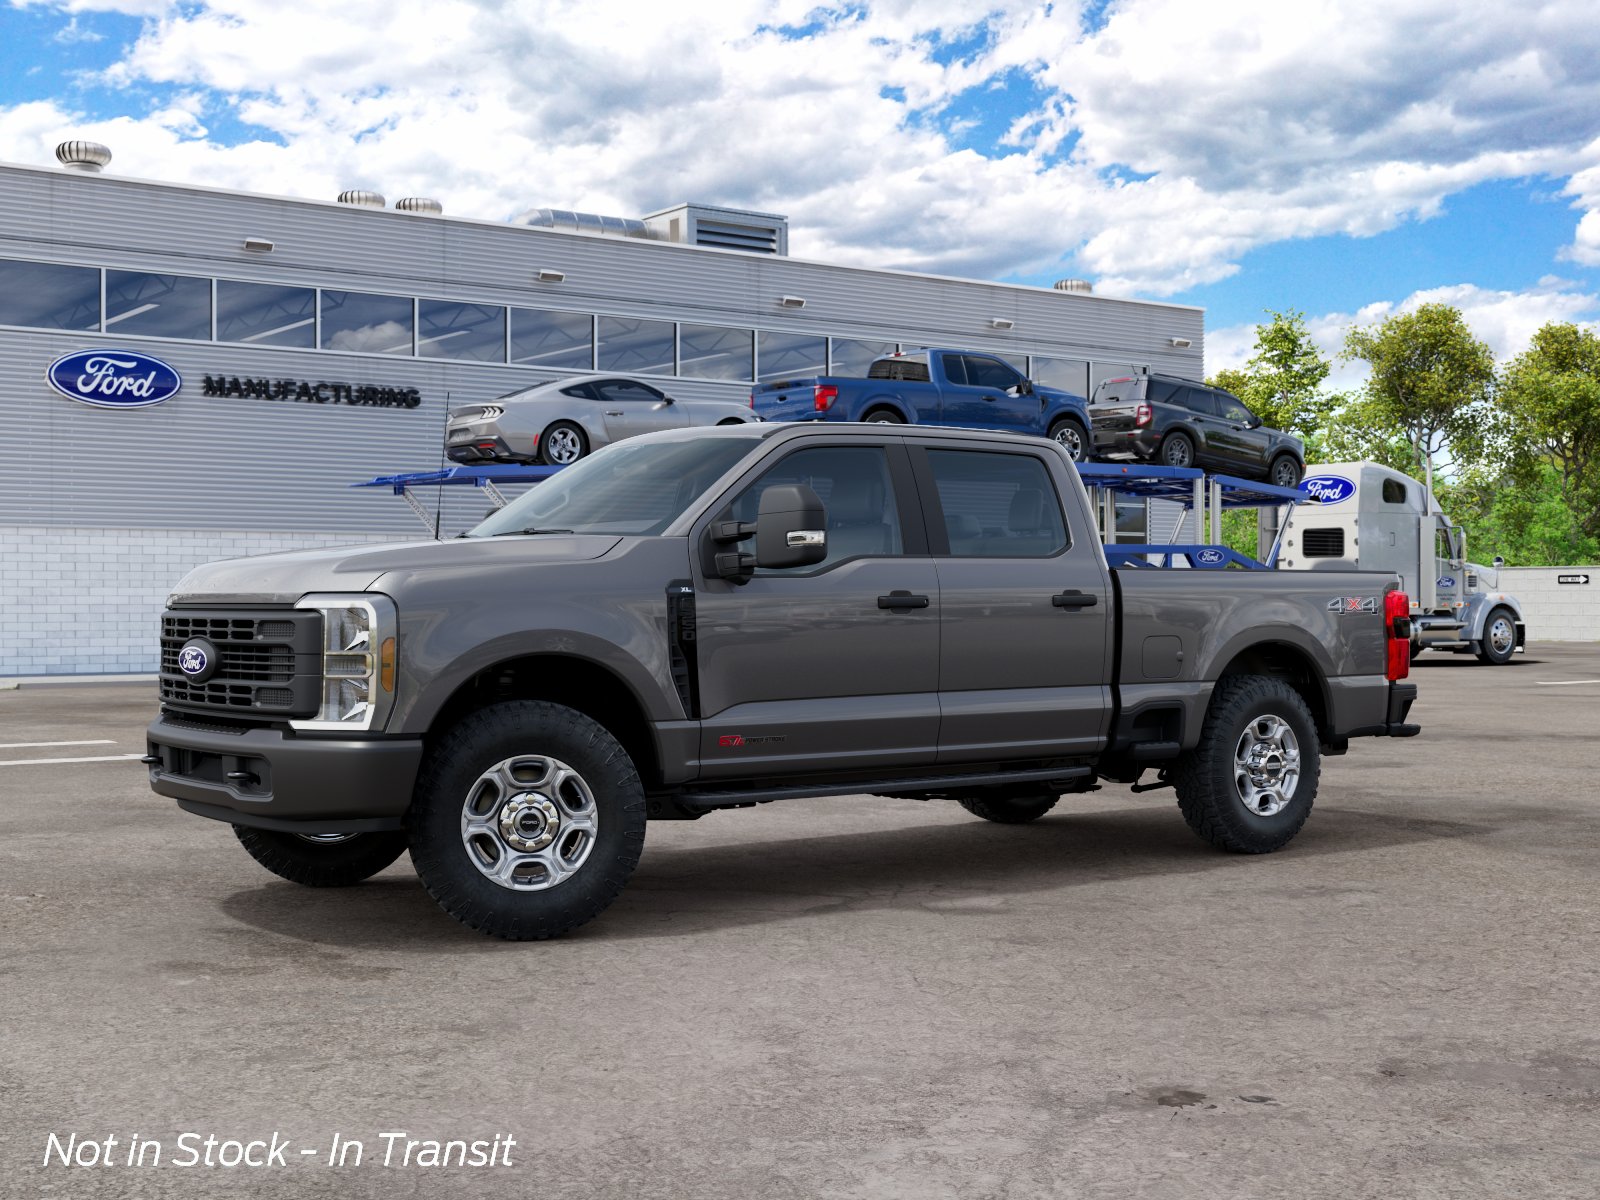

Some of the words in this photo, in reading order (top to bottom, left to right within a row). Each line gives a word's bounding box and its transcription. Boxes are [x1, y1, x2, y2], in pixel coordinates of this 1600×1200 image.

[77, 357, 154, 398] Ford
[203, 373, 421, 408] MANUFACTURING
[1307, 480, 1343, 499] Ford
[183, 650, 202, 670] Ford
